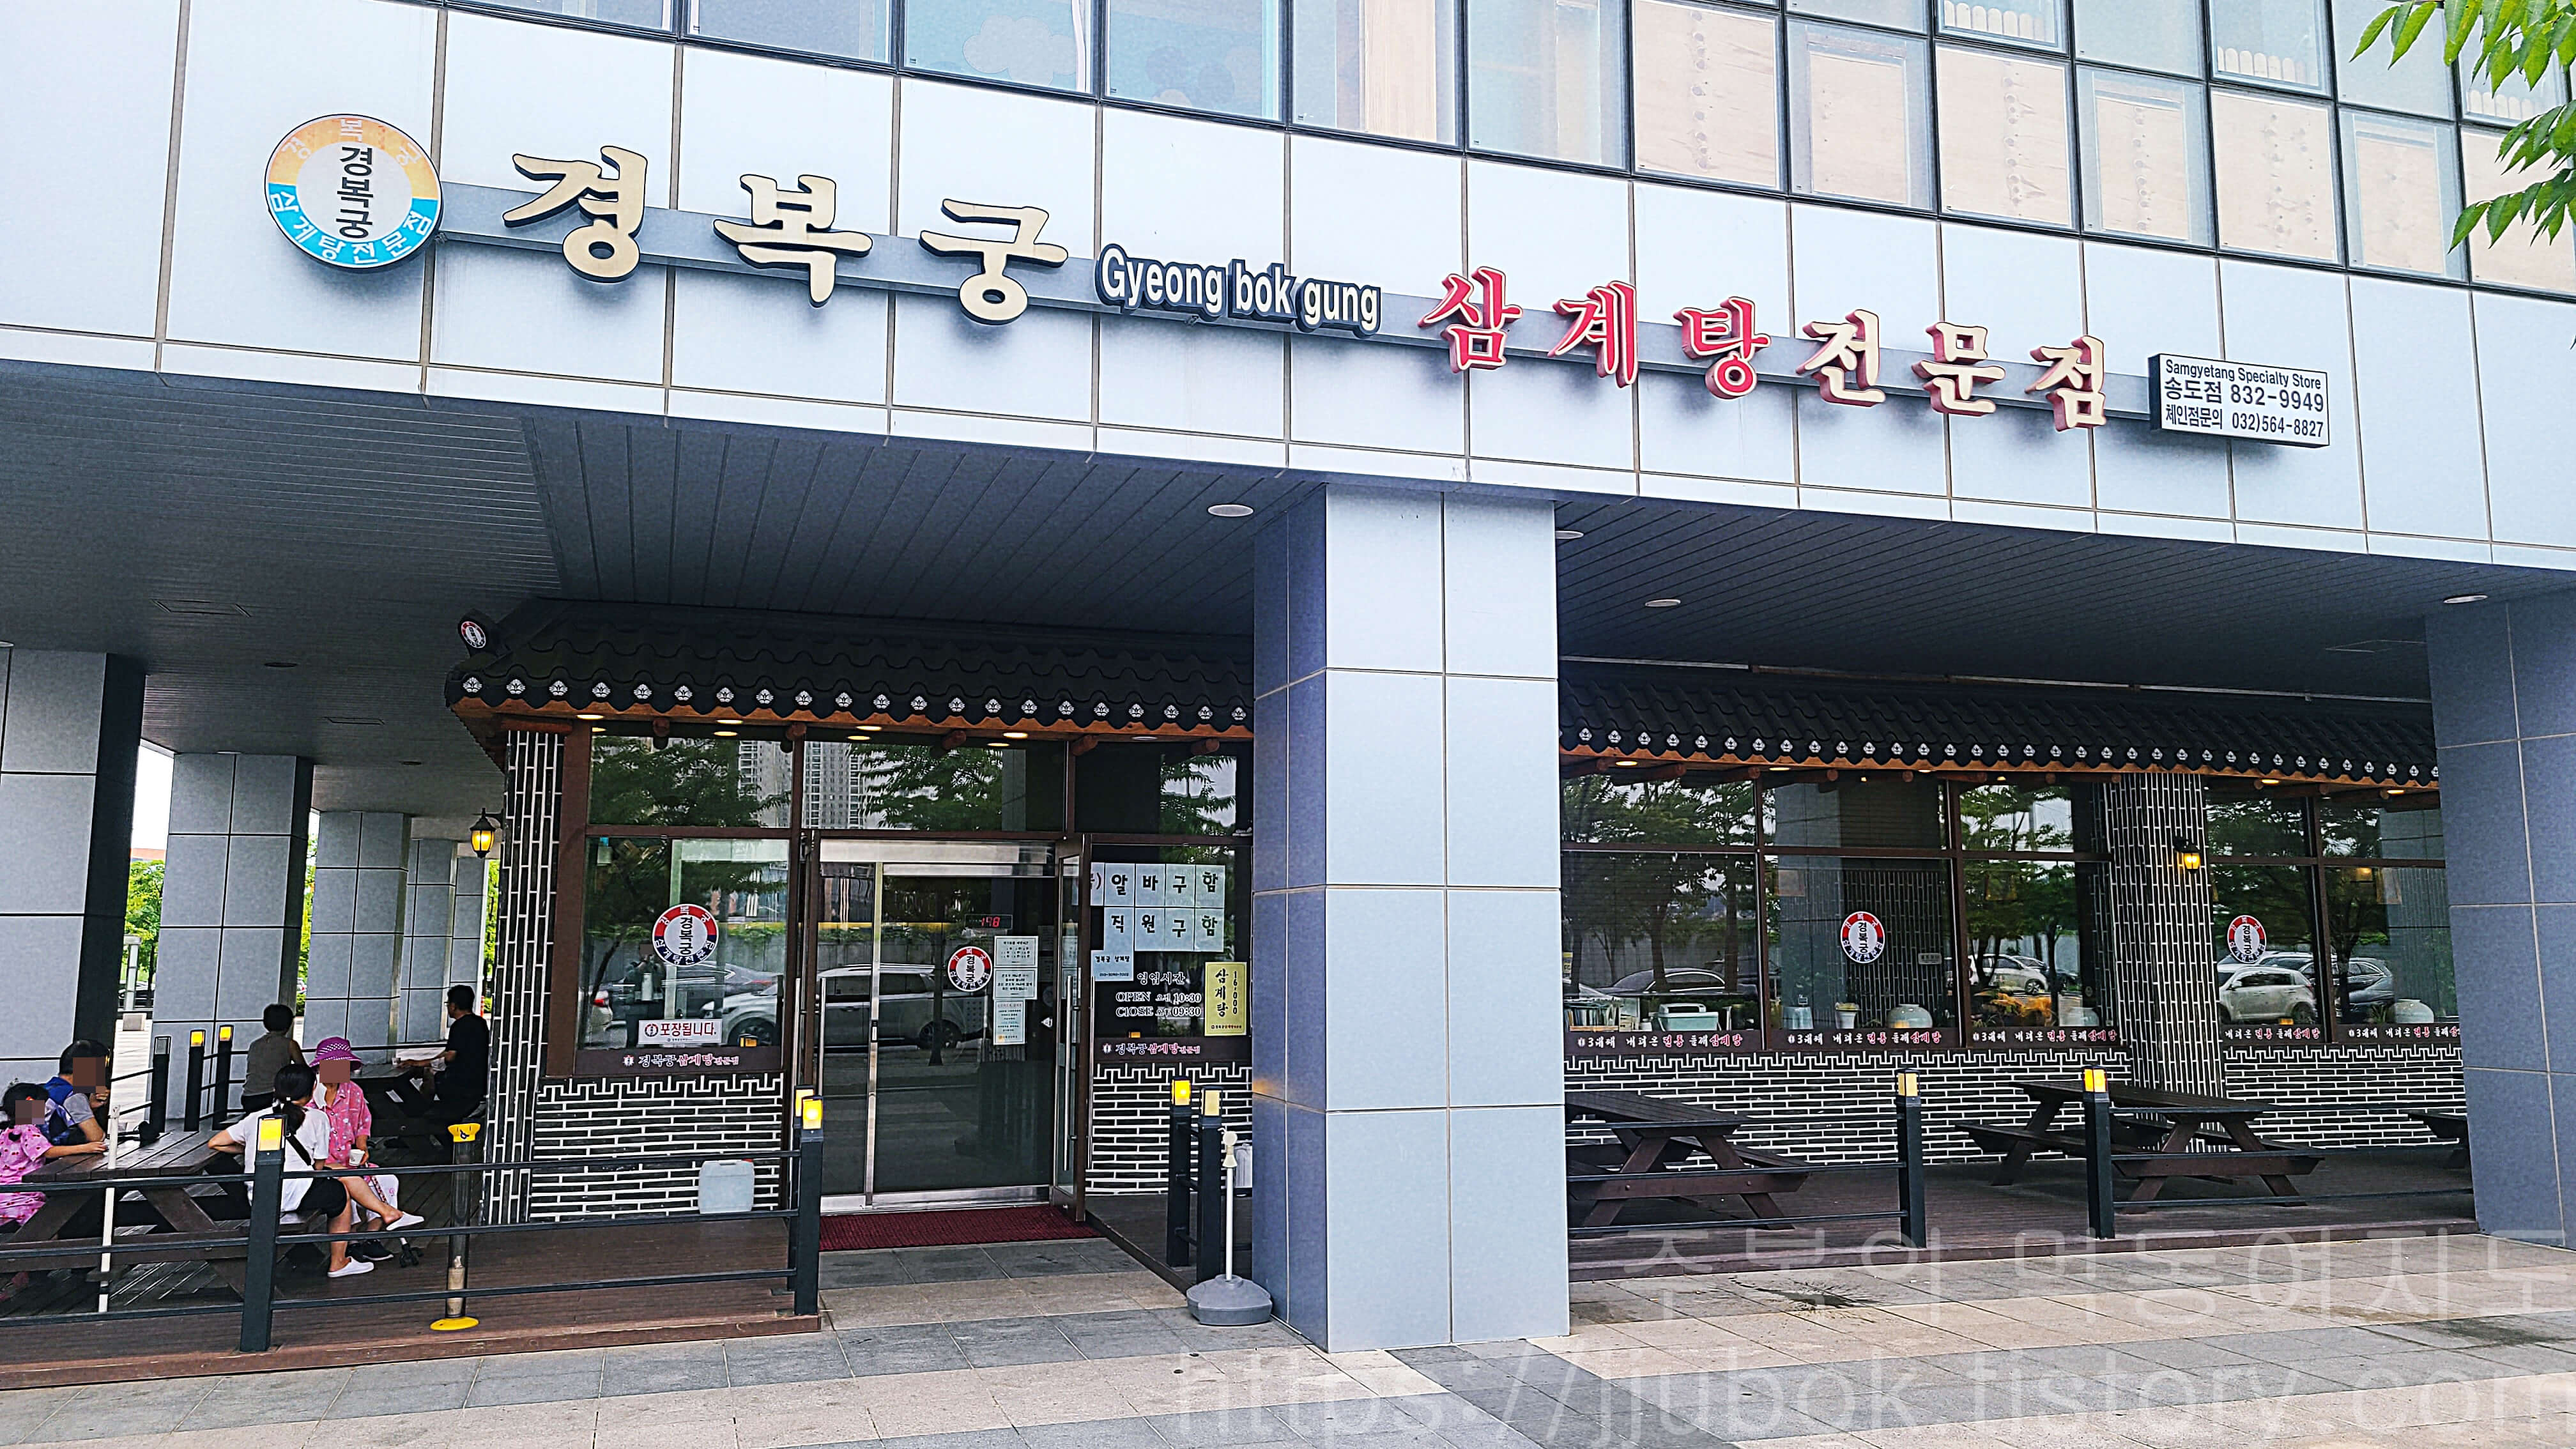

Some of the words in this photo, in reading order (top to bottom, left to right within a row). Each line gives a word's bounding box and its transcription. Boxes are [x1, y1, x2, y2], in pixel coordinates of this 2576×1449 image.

[335, 146, 374, 239] 경복궁
[503, 146, 1068, 325] 경복궁
[1098, 245, 1224, 318] Gyeong
[1234, 261, 1292, 318] bok
[1303, 282, 1380, 334] gung
[2165, 359, 2235, 381] Samgyetang
[2237, 367, 2289, 387] Specialty
[2292, 373, 2322, 390] Store
[2164, 376, 2223, 404] 송도점
[2230, 384, 2324, 412] 832-9949
[2165, 404, 2223, 429] 체인점문의
[2232, 412, 2324, 438] 032)564-8827
[678, 916, 693, 954] 경복궁
[1858, 922, 1869, 953] 경복궁
[2242, 925, 2253, 954] 경복궁
[965, 956, 976, 983] 경복궁
[1137, 972, 1186, 985] 영업시간
[1116, 991, 1151, 1002] OPEN
[1173, 992, 1202, 1004] 10:30
[1215, 968, 1229, 1017] 삼계탕
[1172, 1007, 1202, 1017] 09:30
[660, 1022, 716, 1037] 포장됩니다.
